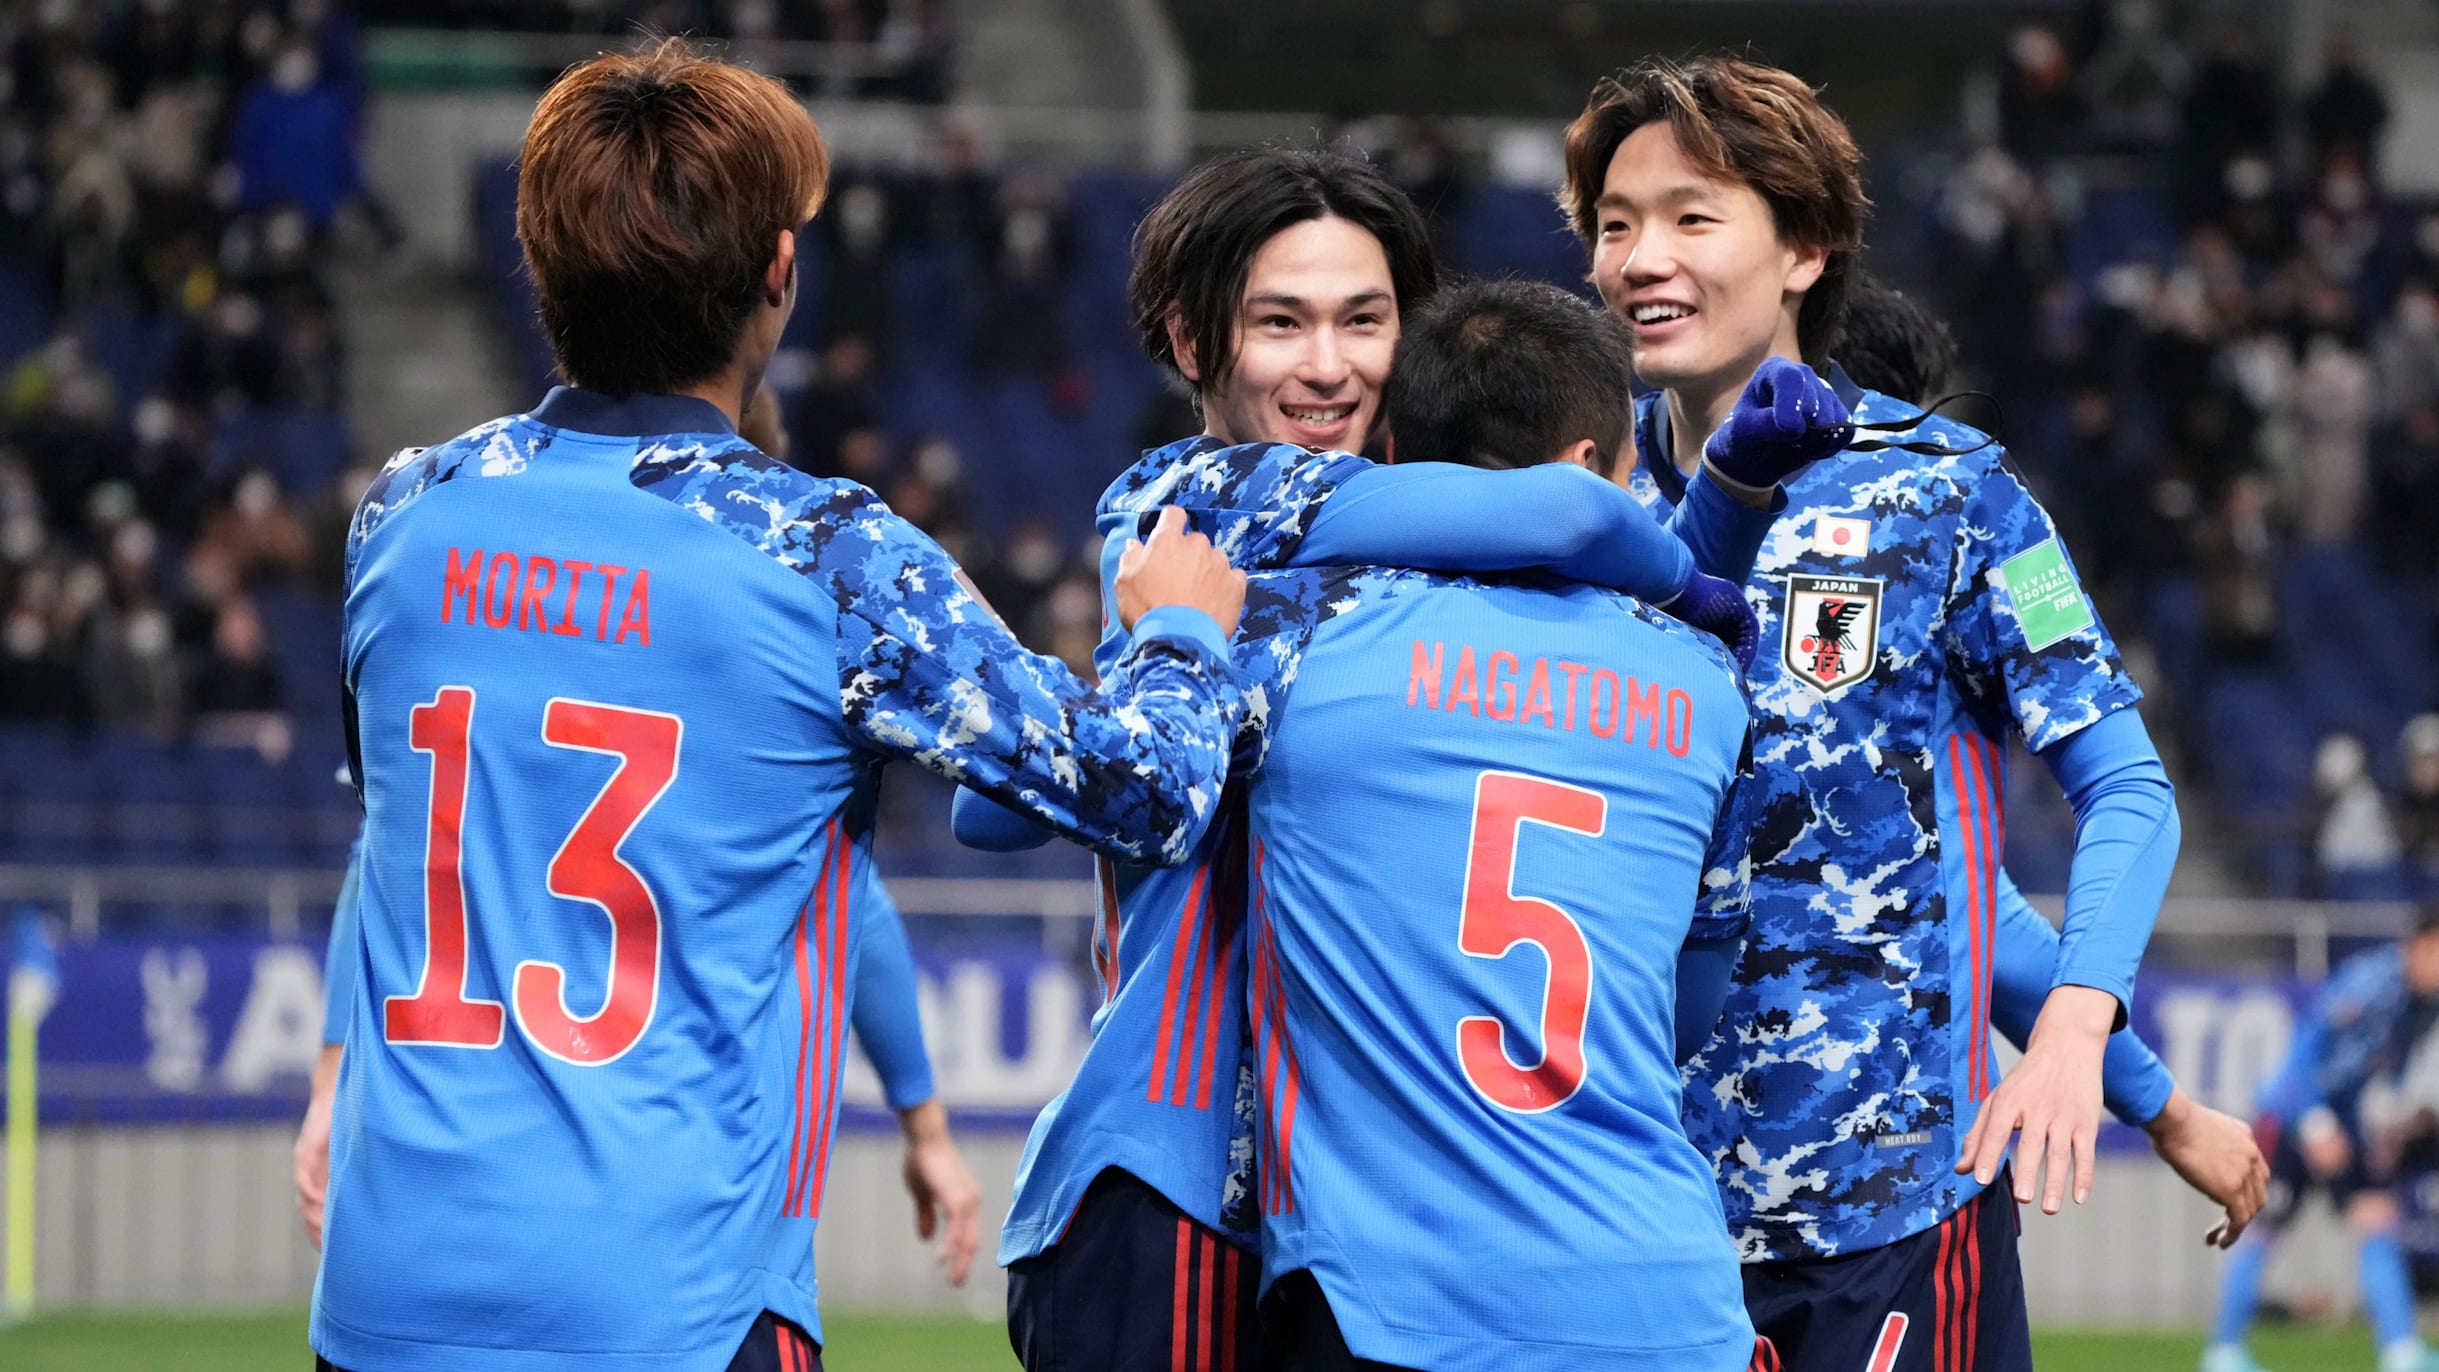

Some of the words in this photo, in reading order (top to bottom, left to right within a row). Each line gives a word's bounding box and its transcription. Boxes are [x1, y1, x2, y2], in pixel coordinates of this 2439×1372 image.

[1811, 580, 1859, 593] JAPAN
[2013, 563, 2066, 595] LIVING
[2017, 574, 2070, 605] FOOTBALL
[441, 547, 650, 646] MORITA
[2053, 591, 2078, 612] FIFA
[1807, 655, 1847, 674] JFA
[1407, 640, 1693, 758] NAGATOMO
[384, 685, 684, 1067] 13
[1456, 769, 1608, 1114] 5
[1885, 1133, 1921, 1146] HEAT.RDY
